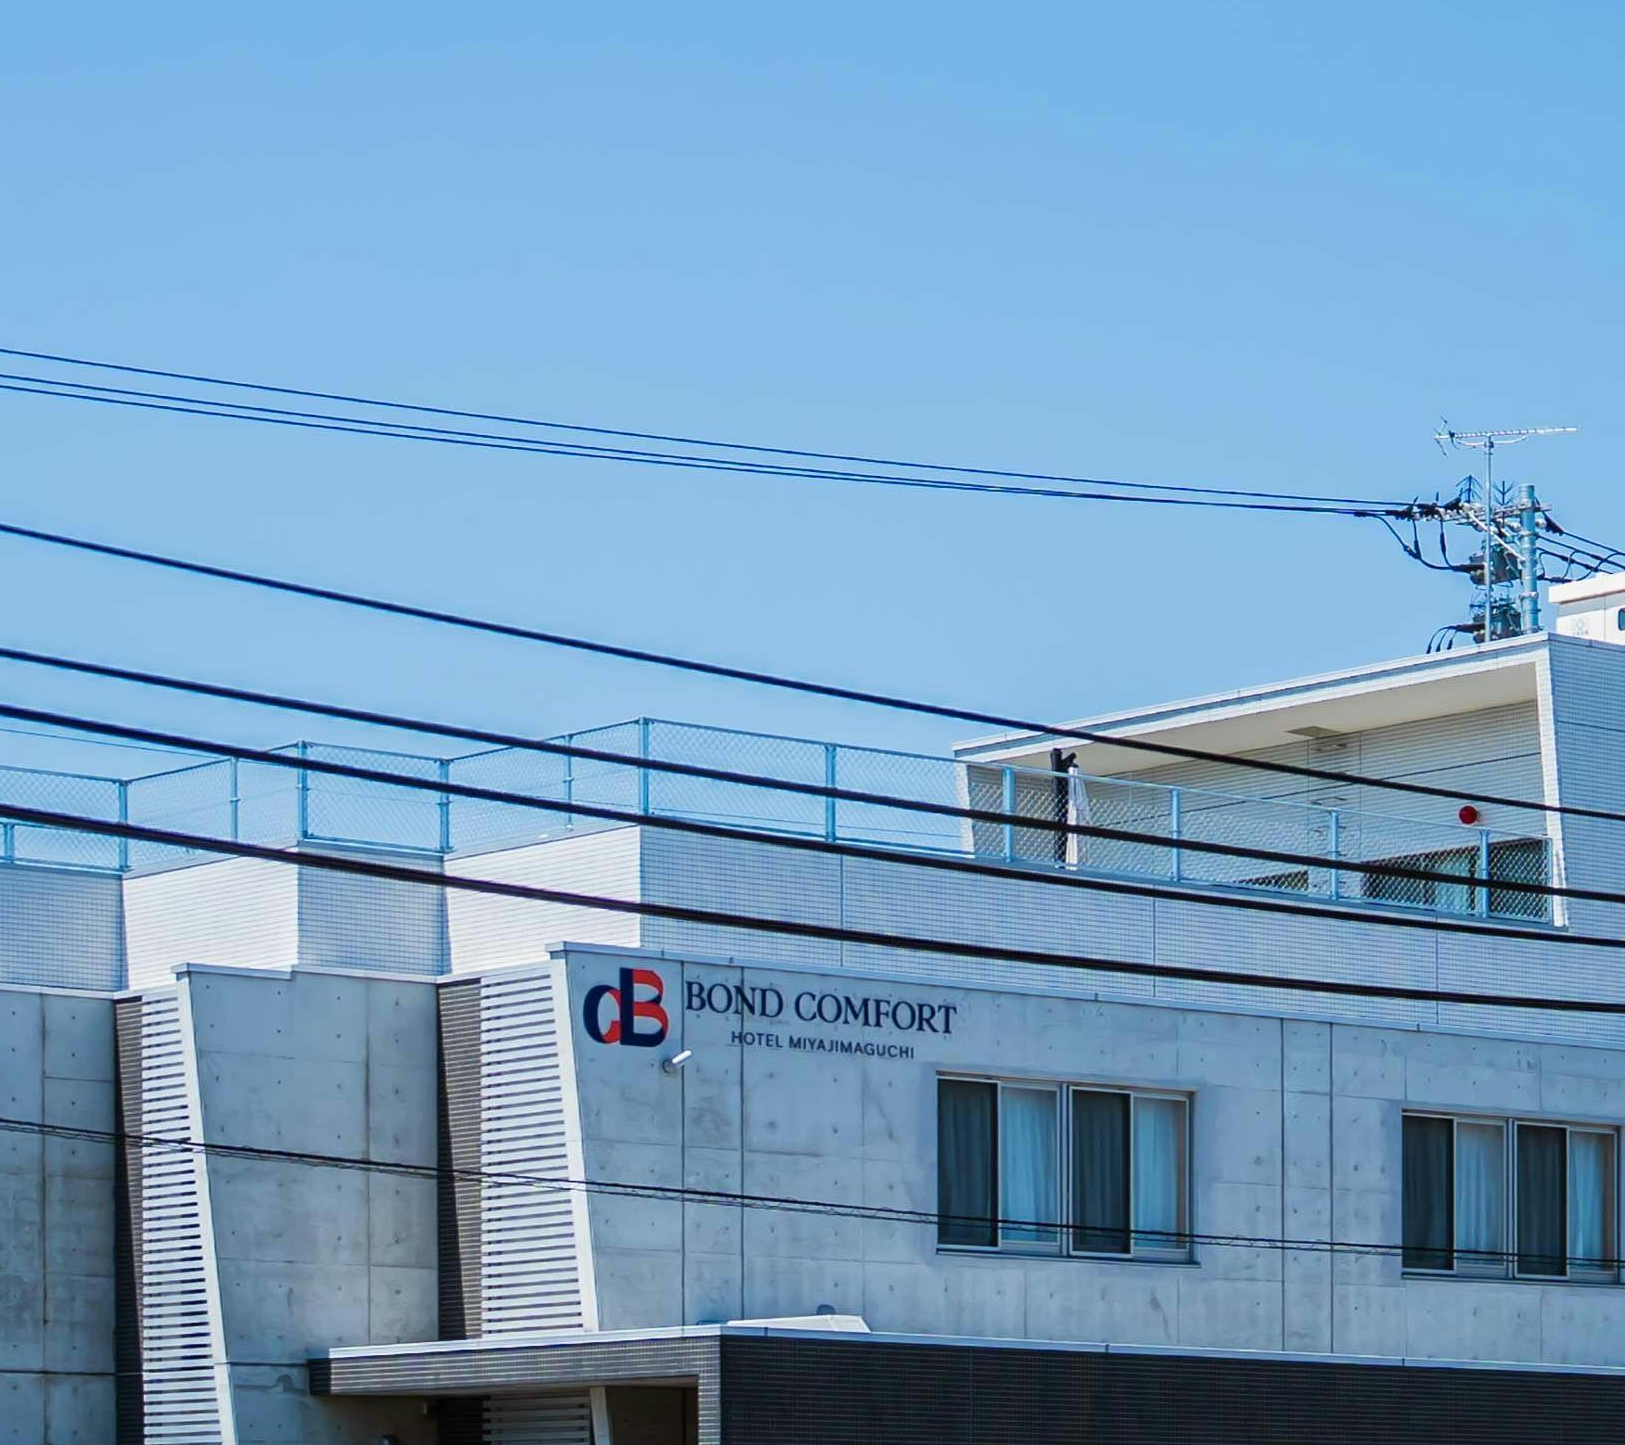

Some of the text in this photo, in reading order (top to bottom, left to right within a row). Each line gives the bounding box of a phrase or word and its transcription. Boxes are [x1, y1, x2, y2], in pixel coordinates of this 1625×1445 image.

[685, 980, 957, 1035] BOND COMFORT
[731, 1031, 915, 1060] HOTEL MIYAJIMAGUCHI
